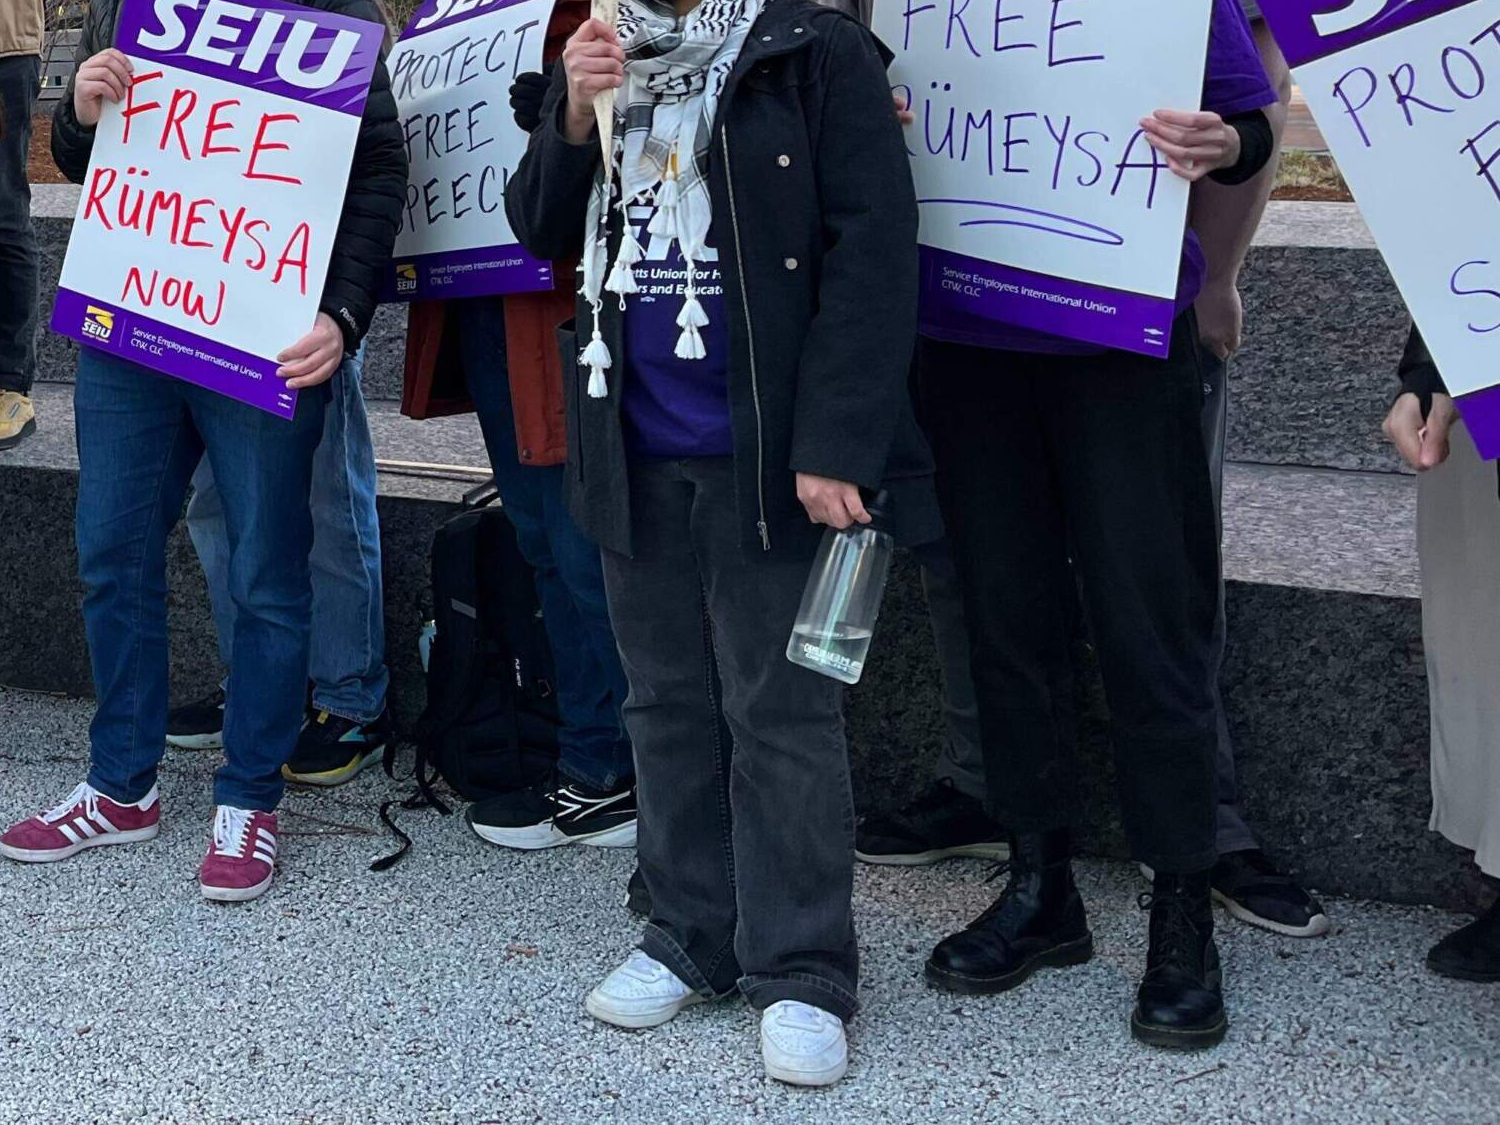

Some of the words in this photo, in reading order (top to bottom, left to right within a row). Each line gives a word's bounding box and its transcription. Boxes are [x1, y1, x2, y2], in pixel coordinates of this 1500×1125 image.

[392, 19, 539, 100] PROTECT
[121, 71, 302, 185] FREE
[403, 101, 494, 164] FREE
[397, 165, 508, 231] PEEC
[83, 167, 311, 296] RÜMEYSA
[121, 267, 226, 326] NOW
[650, 284, 674, 294] and
[651, 268, 687, 279] Union
[942, 267, 971, 282] Service
[973, 274, 1019, 294] Employees
[1021, 285, 1082, 308] International
[1084, 300, 1117, 315] Union
[964, 285, 981, 297] CLC
[82, 321, 111, 339] SEIU
[132, 327, 156, 342] Service
[157, 336, 194, 356] Employees
[195, 348, 239, 372] International
[240, 364, 262, 380] Union
[149, 344, 164, 356] CLC
